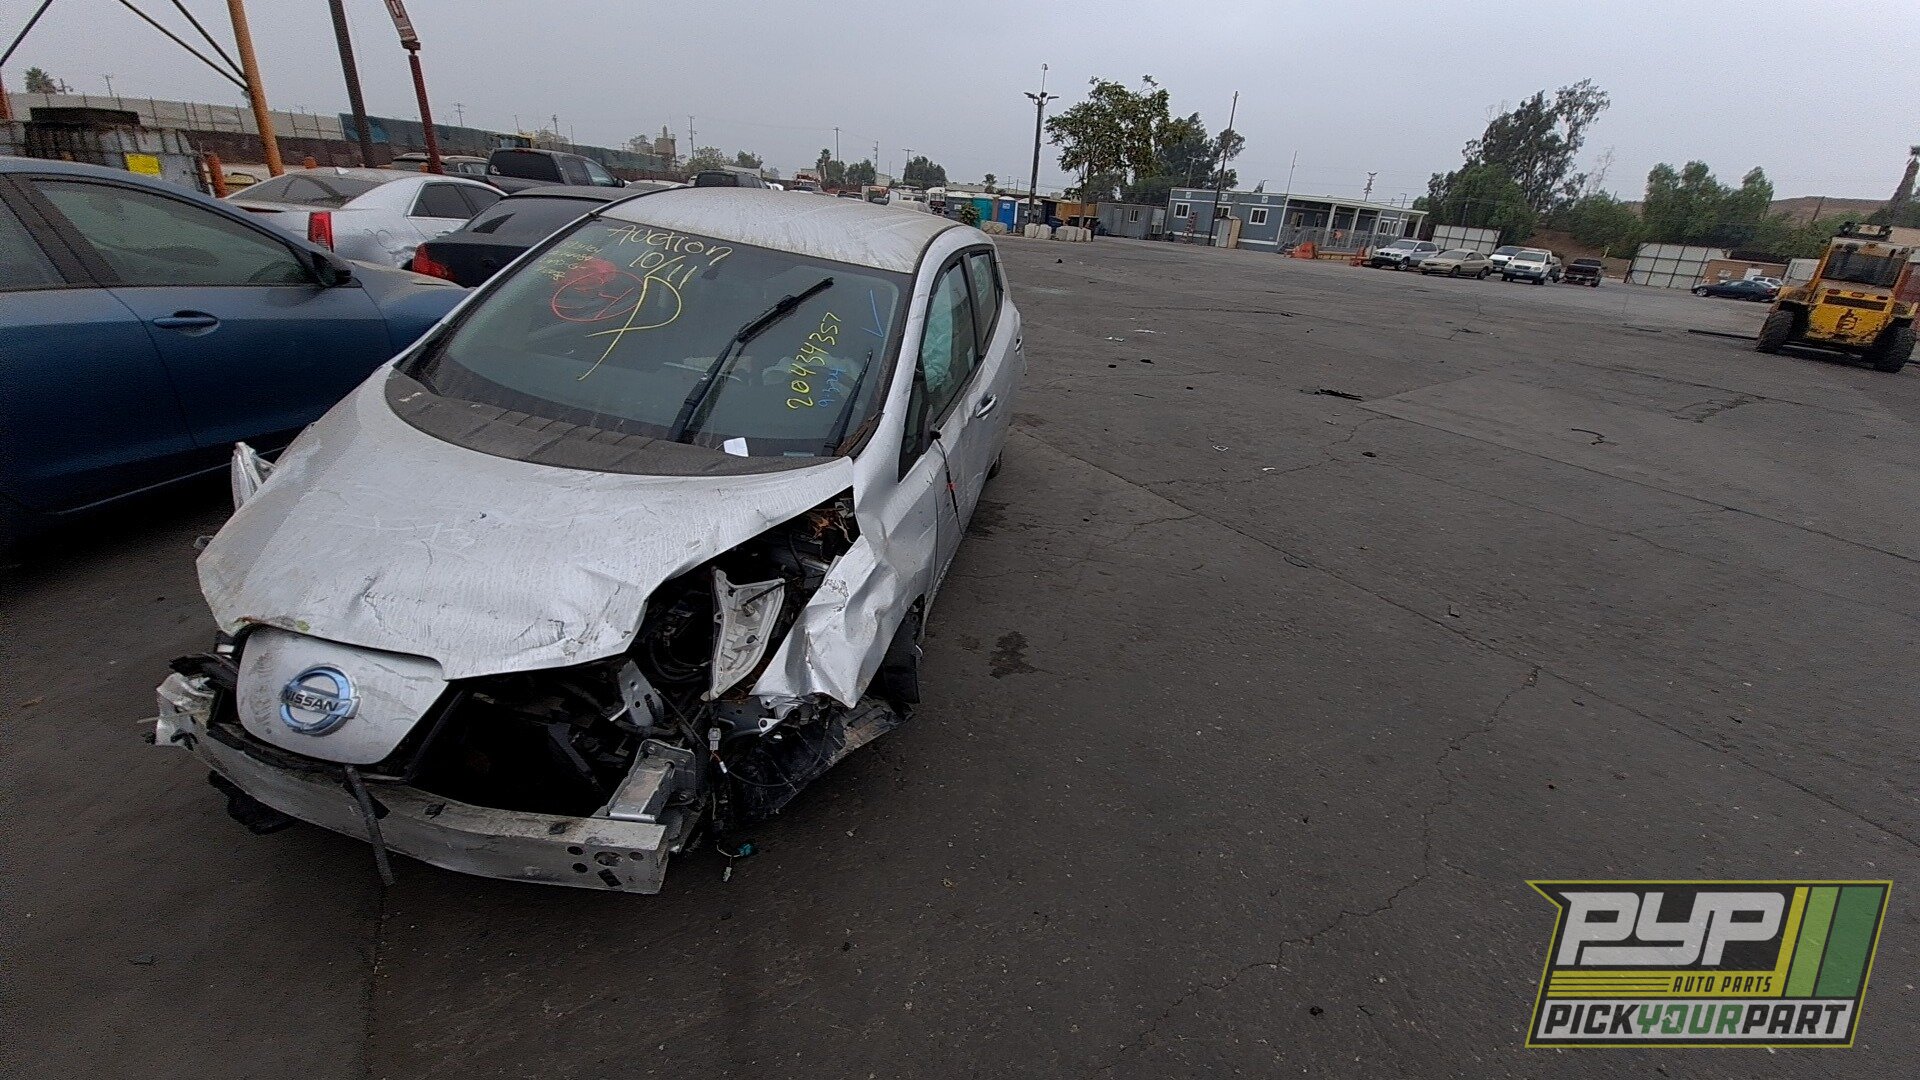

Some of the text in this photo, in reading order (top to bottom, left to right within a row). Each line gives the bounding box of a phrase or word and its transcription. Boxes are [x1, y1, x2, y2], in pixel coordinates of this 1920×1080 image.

[629, 250, 697, 289] 10/11
[787, 312, 841, 408] 20434357
[281, 690, 339, 712] NISSAN
